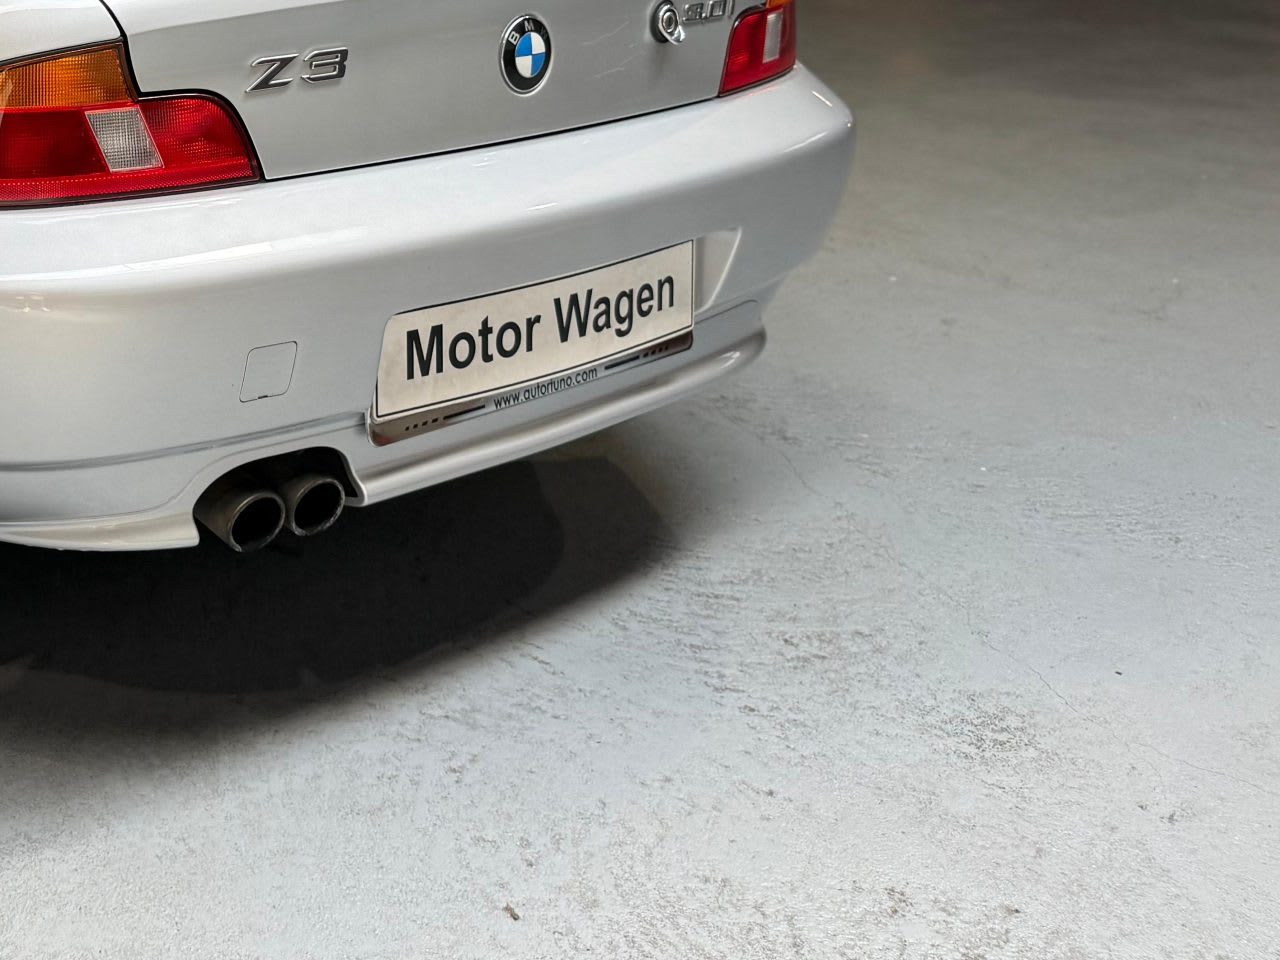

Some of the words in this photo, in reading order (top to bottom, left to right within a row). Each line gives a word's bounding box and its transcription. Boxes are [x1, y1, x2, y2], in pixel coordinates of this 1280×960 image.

[245, 46, 349, 93] Z3
[405, 315, 541, 380] Motor
[553, 275, 674, 344] Wagen
